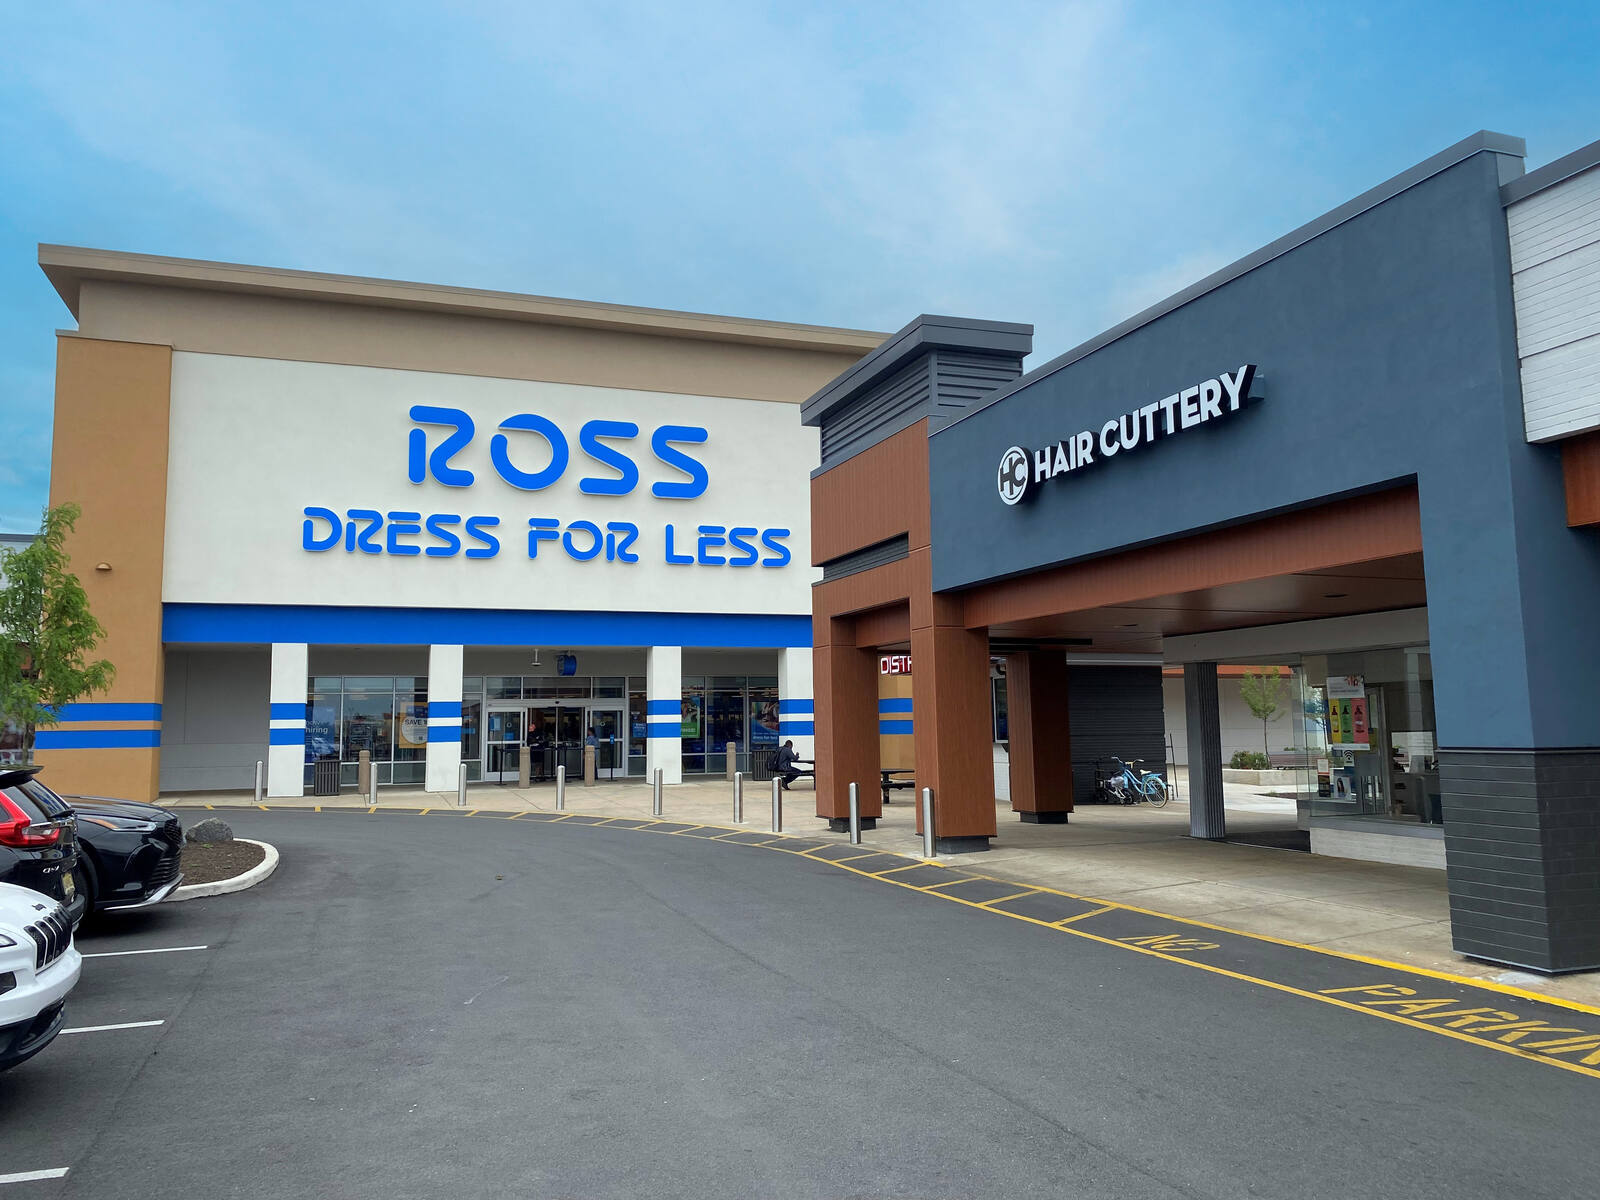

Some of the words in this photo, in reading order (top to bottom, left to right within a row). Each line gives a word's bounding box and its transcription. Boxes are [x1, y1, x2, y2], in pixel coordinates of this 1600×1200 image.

[408, 405, 709, 500] ROSS
[1034, 430, 1095, 483] HAIR
[1100, 364, 1249, 457] CUTTERY
[302, 506, 502, 559] DRESS
[528, 517, 640, 563] FOR
[665, 524, 792, 567] LESS
[305, 726, 329, 735] hiring
[1116, 934, 1221, 952] NO
